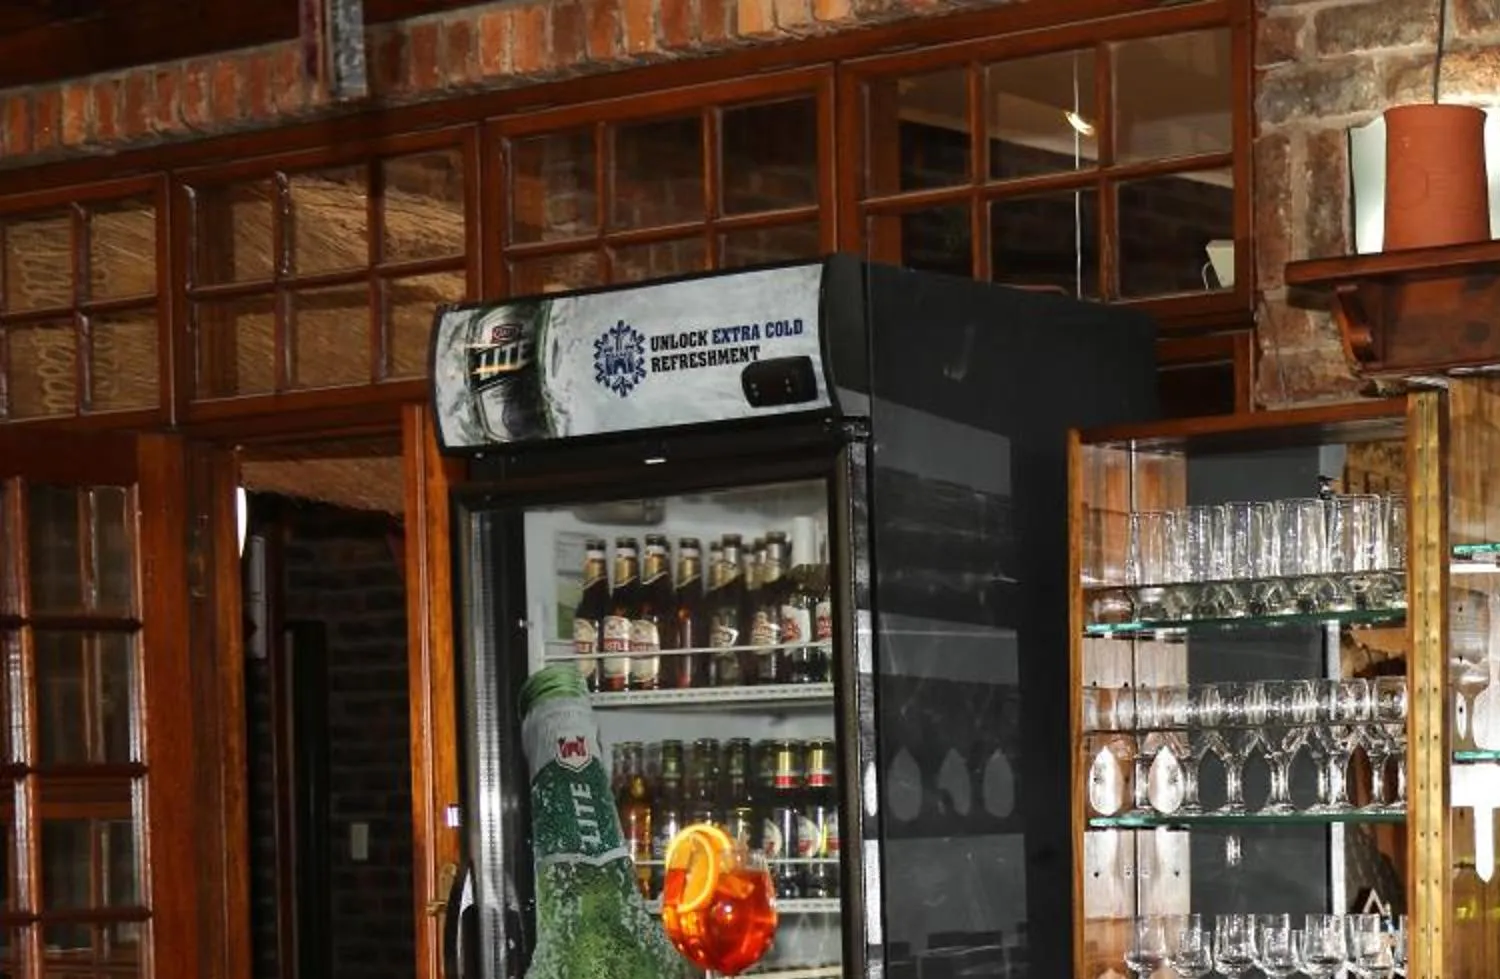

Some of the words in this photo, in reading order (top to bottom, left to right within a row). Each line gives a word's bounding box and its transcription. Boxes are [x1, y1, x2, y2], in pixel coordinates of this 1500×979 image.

[650, 330, 708, 352] UNLOCK
[711, 324, 761, 345] EXTRA
[765, 319, 803, 338] COLD
[650, 345, 760, 373] REFRESHMENT
[569, 783, 603, 851] LITE
